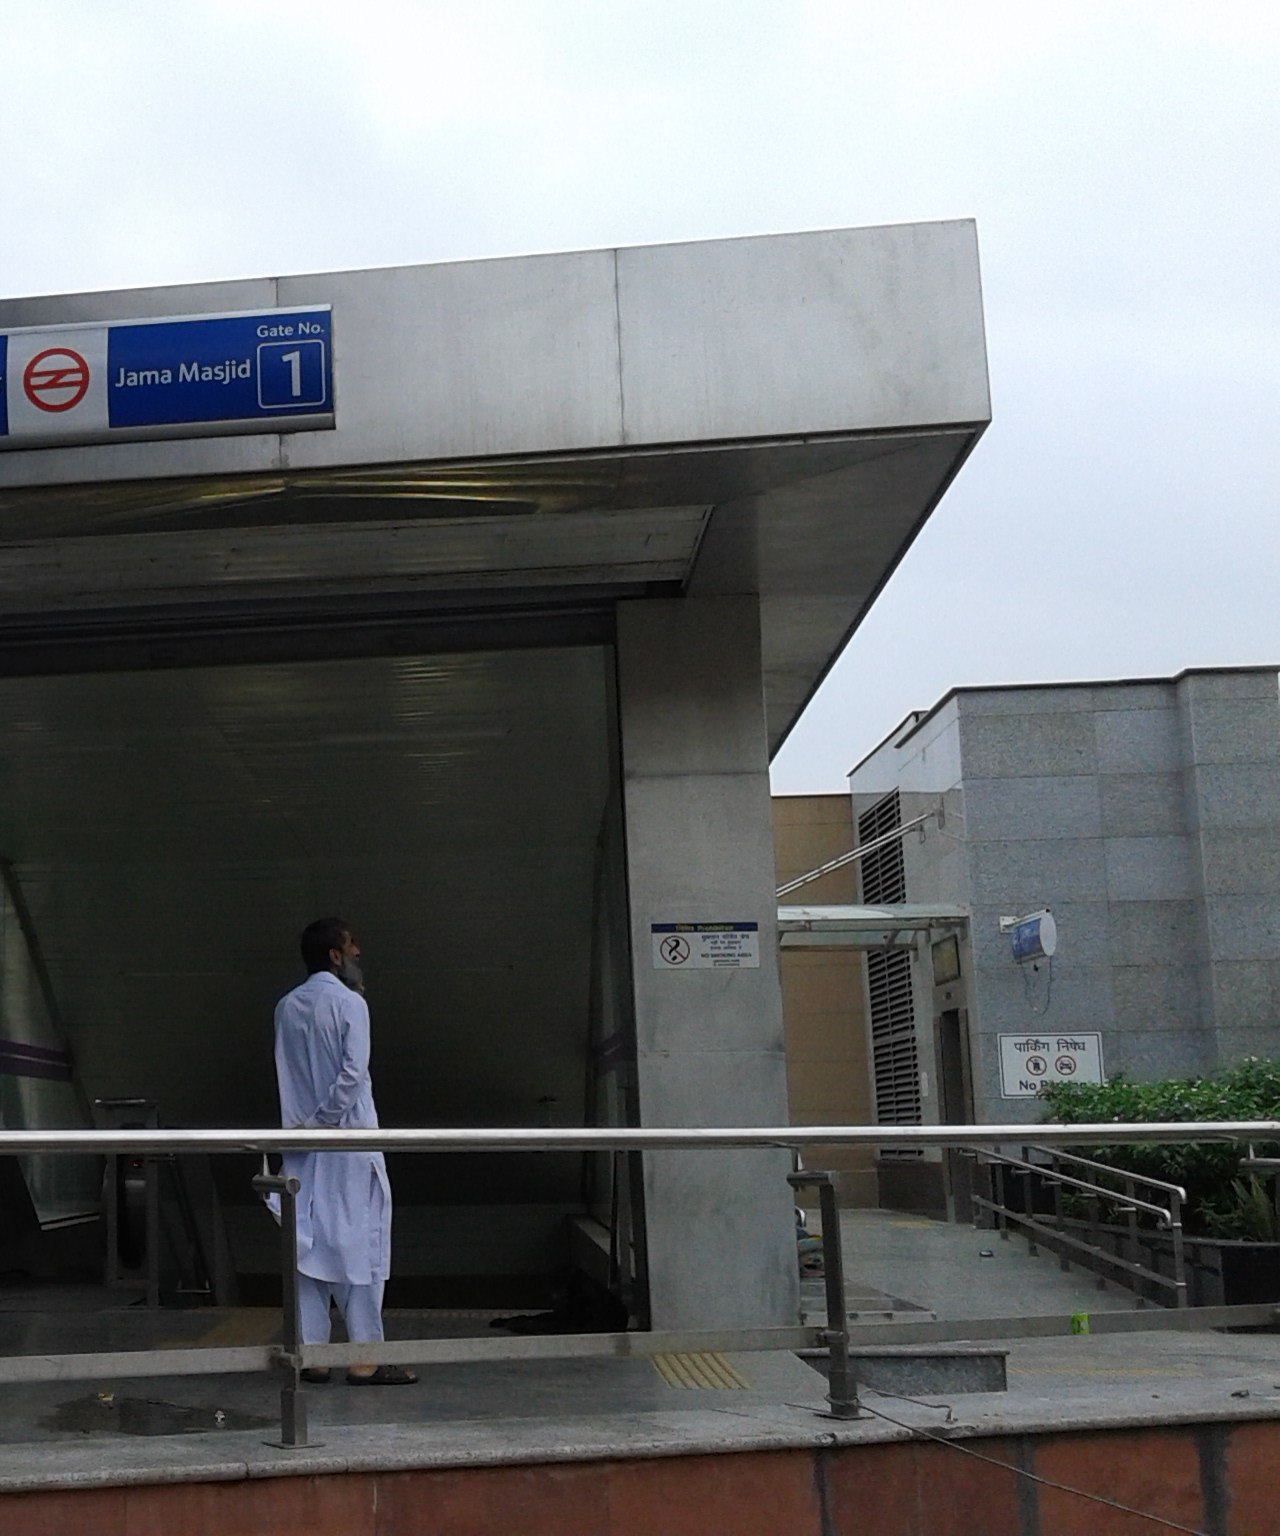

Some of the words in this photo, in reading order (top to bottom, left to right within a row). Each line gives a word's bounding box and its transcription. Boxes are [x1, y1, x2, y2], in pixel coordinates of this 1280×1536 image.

[256, 324, 294, 338] Gate
[298, 322, 325, 335] No.
[115, 367, 172, 388] Jama
[178, 358, 251, 385] Masjid
[282, 350, 301, 397] 1
[1019, 1081, 1037, 1091] No
